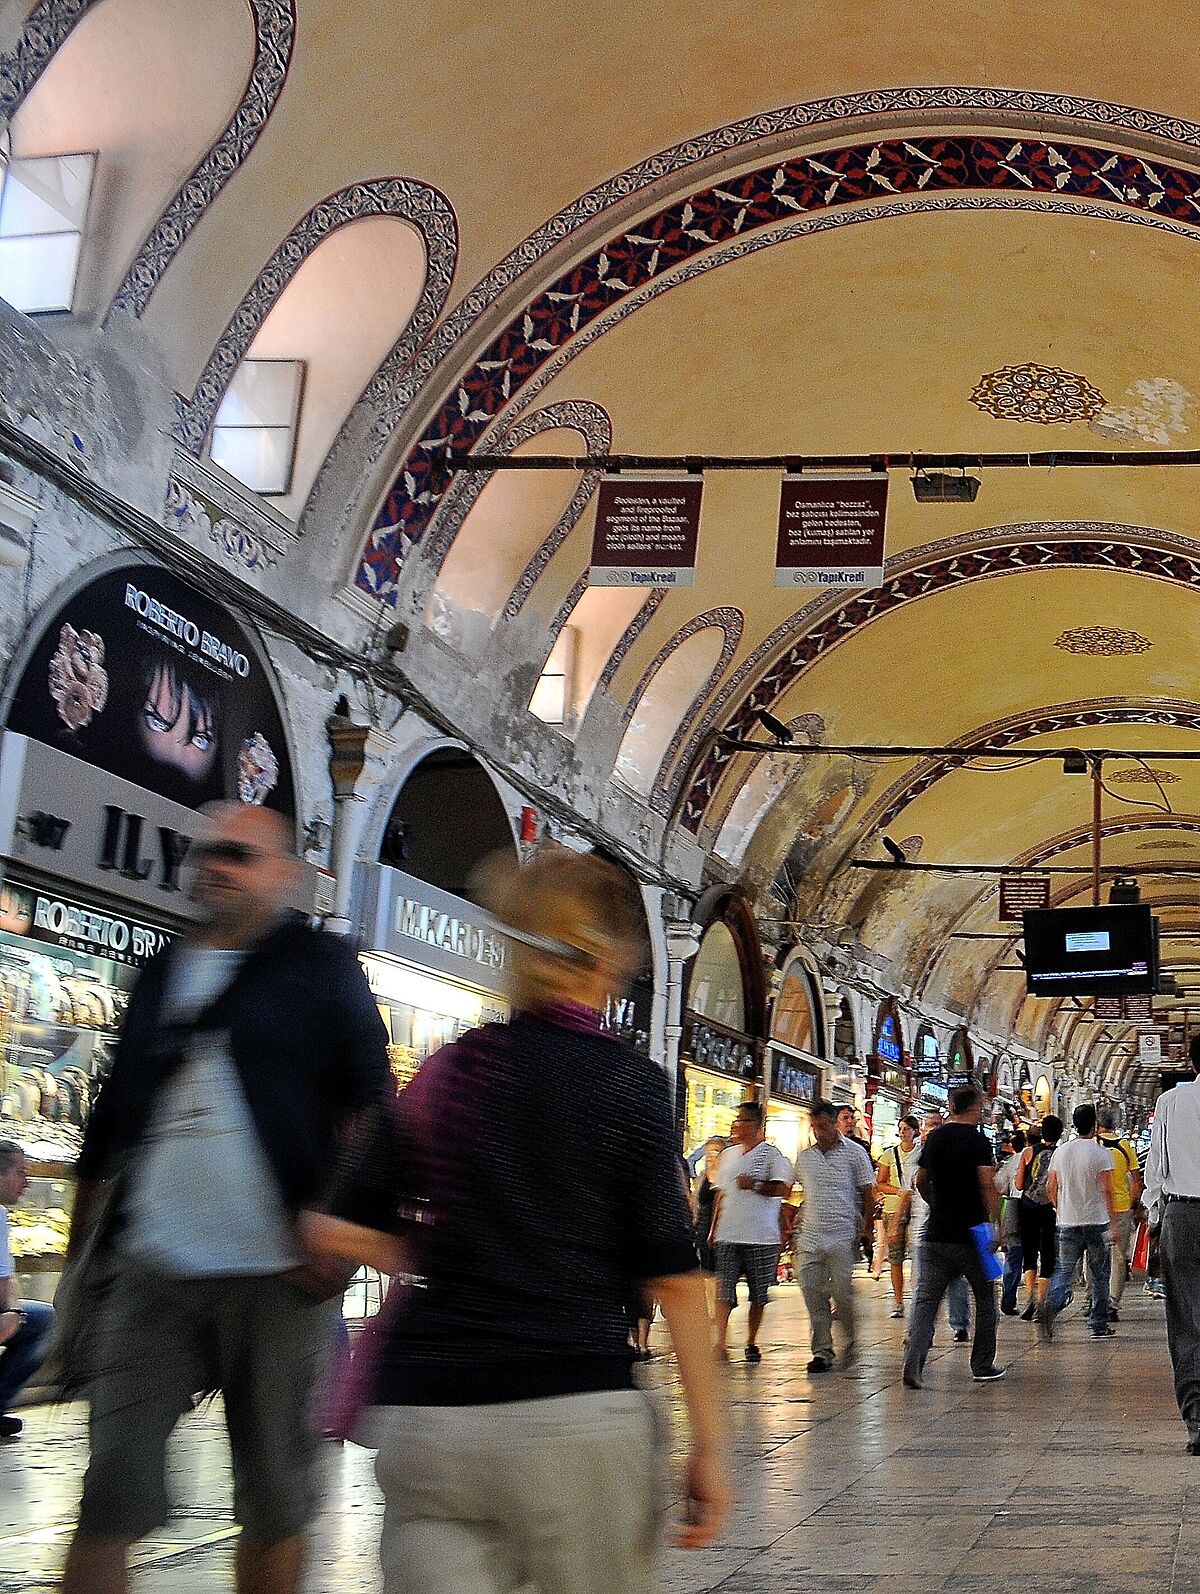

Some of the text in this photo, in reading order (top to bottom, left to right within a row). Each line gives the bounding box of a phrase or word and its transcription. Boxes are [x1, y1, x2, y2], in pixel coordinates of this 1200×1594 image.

[124, 582, 251, 678] ROBERTO BRAVO
[33, 896, 130, 951] ROBERTO
